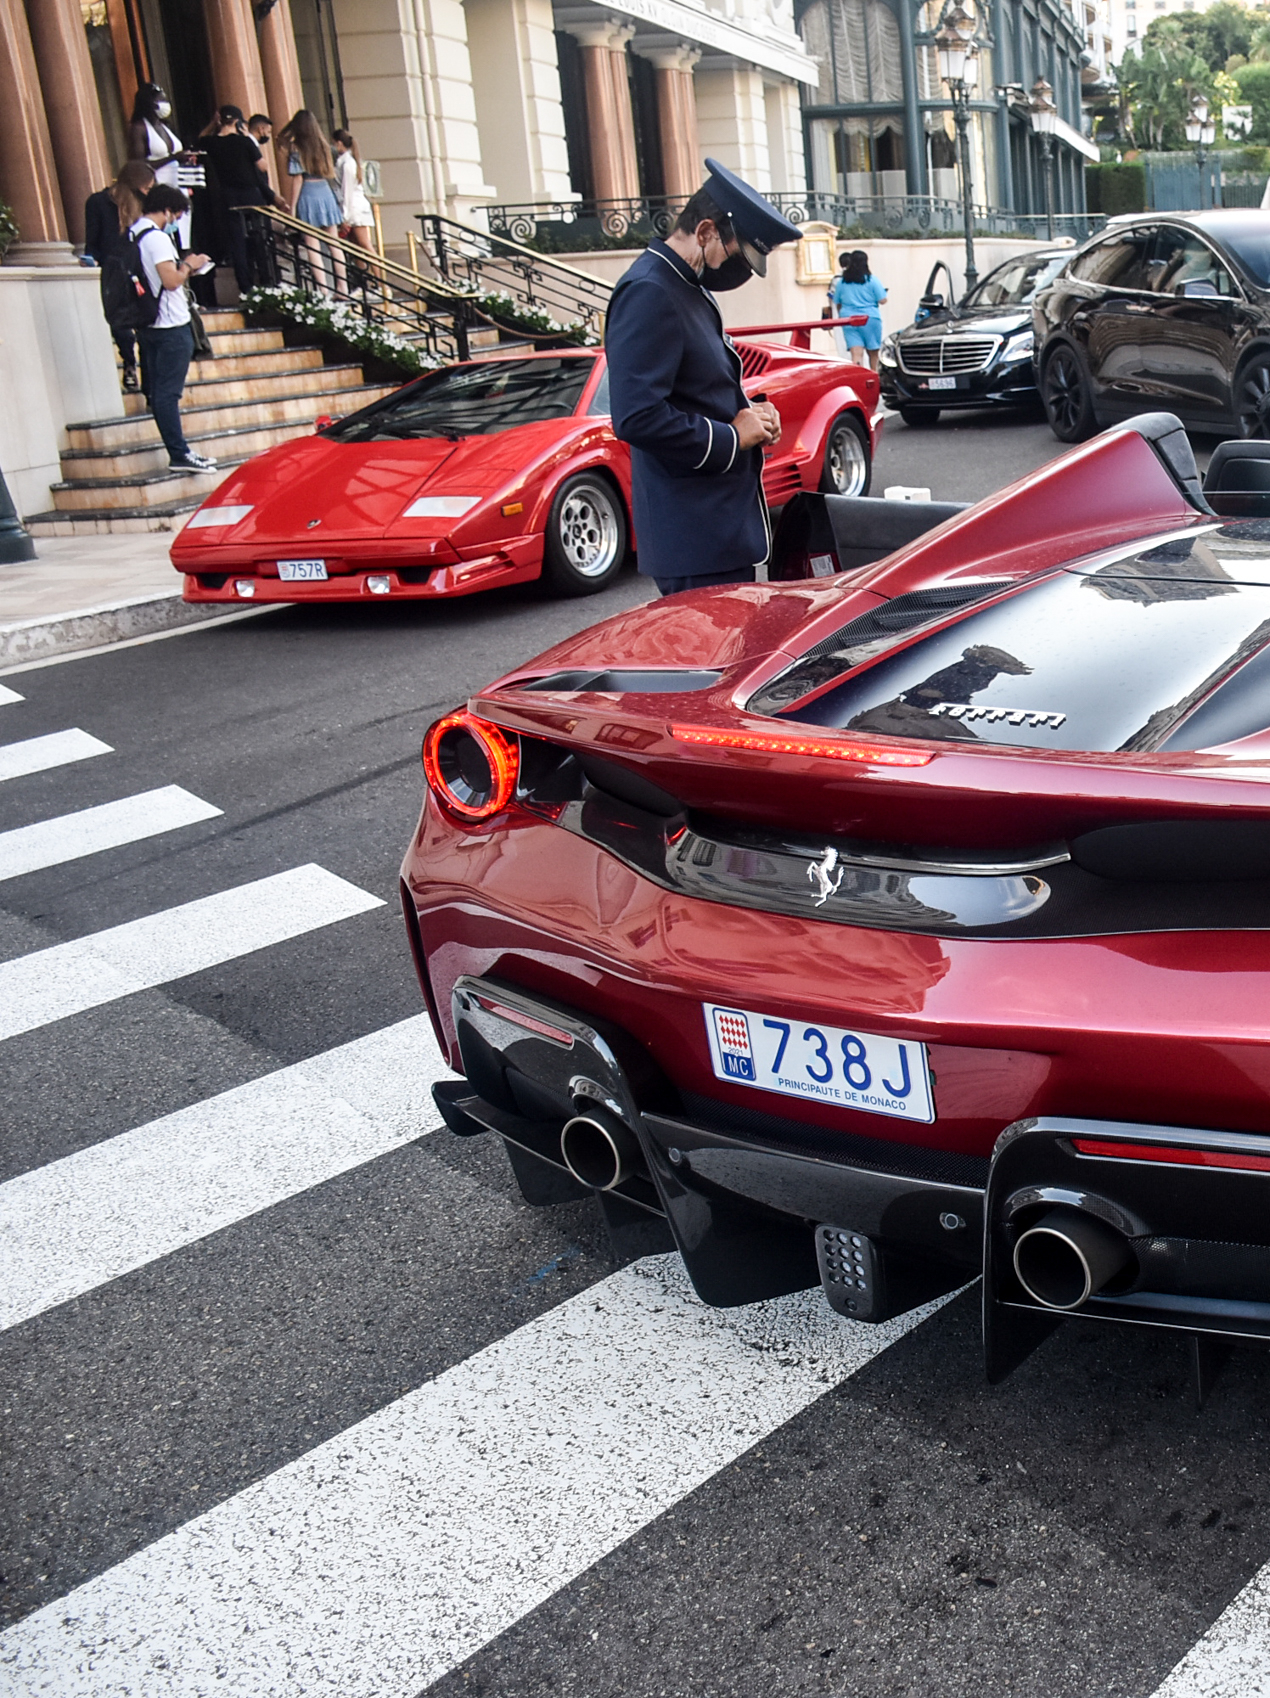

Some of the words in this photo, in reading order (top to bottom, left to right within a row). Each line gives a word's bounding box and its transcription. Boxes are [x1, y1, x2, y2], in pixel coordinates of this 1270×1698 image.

[289, 562, 324, 578] 757R
[926, 702, 1067, 728] Ferrari
[727, 1055, 749, 1076] MC
[763, 1018, 912, 1098] 738J
[777, 1077, 841, 1098] PRINCIPAUTE
[844, 1090, 859, 1102] DE
[861, 1094, 907, 1111] MONACO
